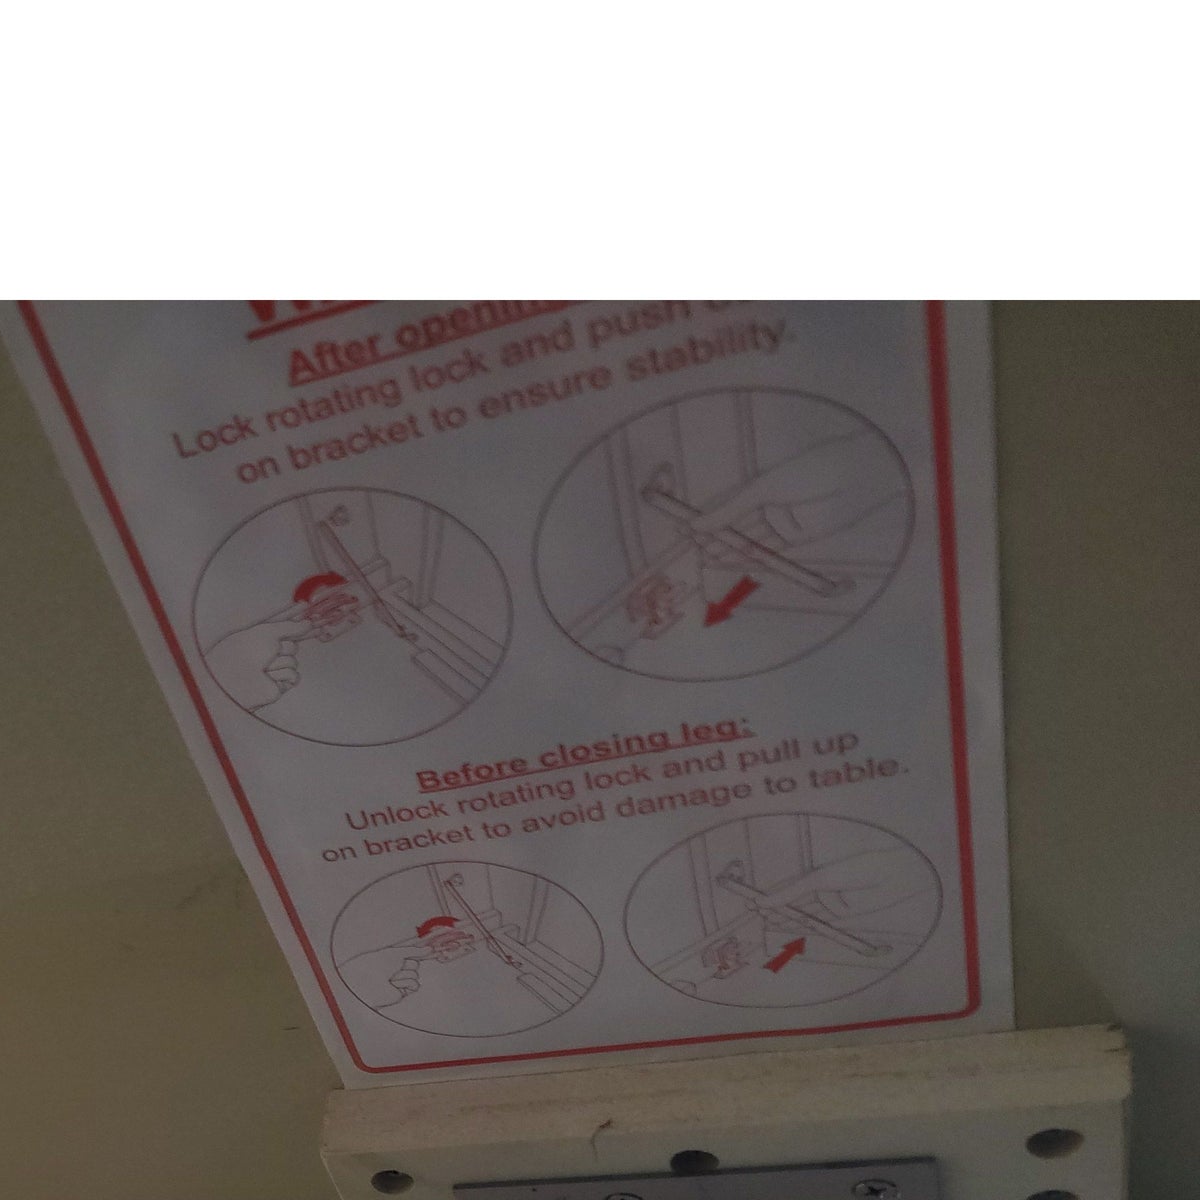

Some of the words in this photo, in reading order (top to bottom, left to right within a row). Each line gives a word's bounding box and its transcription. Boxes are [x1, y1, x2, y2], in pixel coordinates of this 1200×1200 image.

[172, 414, 259, 459] Lock
[264, 378, 402, 432] rotating
[407, 346, 490, 391] lock
[500, 318, 575, 368] and
[586, 301, 692, 351] push
[236, 454, 281, 484] on
[286, 412, 426, 472] bracket
[429, 404, 468, 432] to
[478, 366, 613, 419] ensure
[624, 318, 797, 382] stability.
[289, 332, 383, 387] After
[345, 800, 450, 830] Unlock
[457, 779, 576, 815] rotating
[584, 763, 652, 791] lock
[662, 750, 726, 779] and
[737, 737, 800, 772] pull
[811, 731, 860, 757] up
[415, 756, 529, 794] Before
[536, 728, 672, 769] closing
[680, 716, 757, 744] leg:
[322, 845, 358, 862] on
[364, 824, 475, 857] bracket
[481, 821, 512, 840] to
[520, 800, 606, 833] avoid
[615, 783, 752, 819] damage
[763, 775, 797, 795] to
[807, 756, 910, 789] table.
